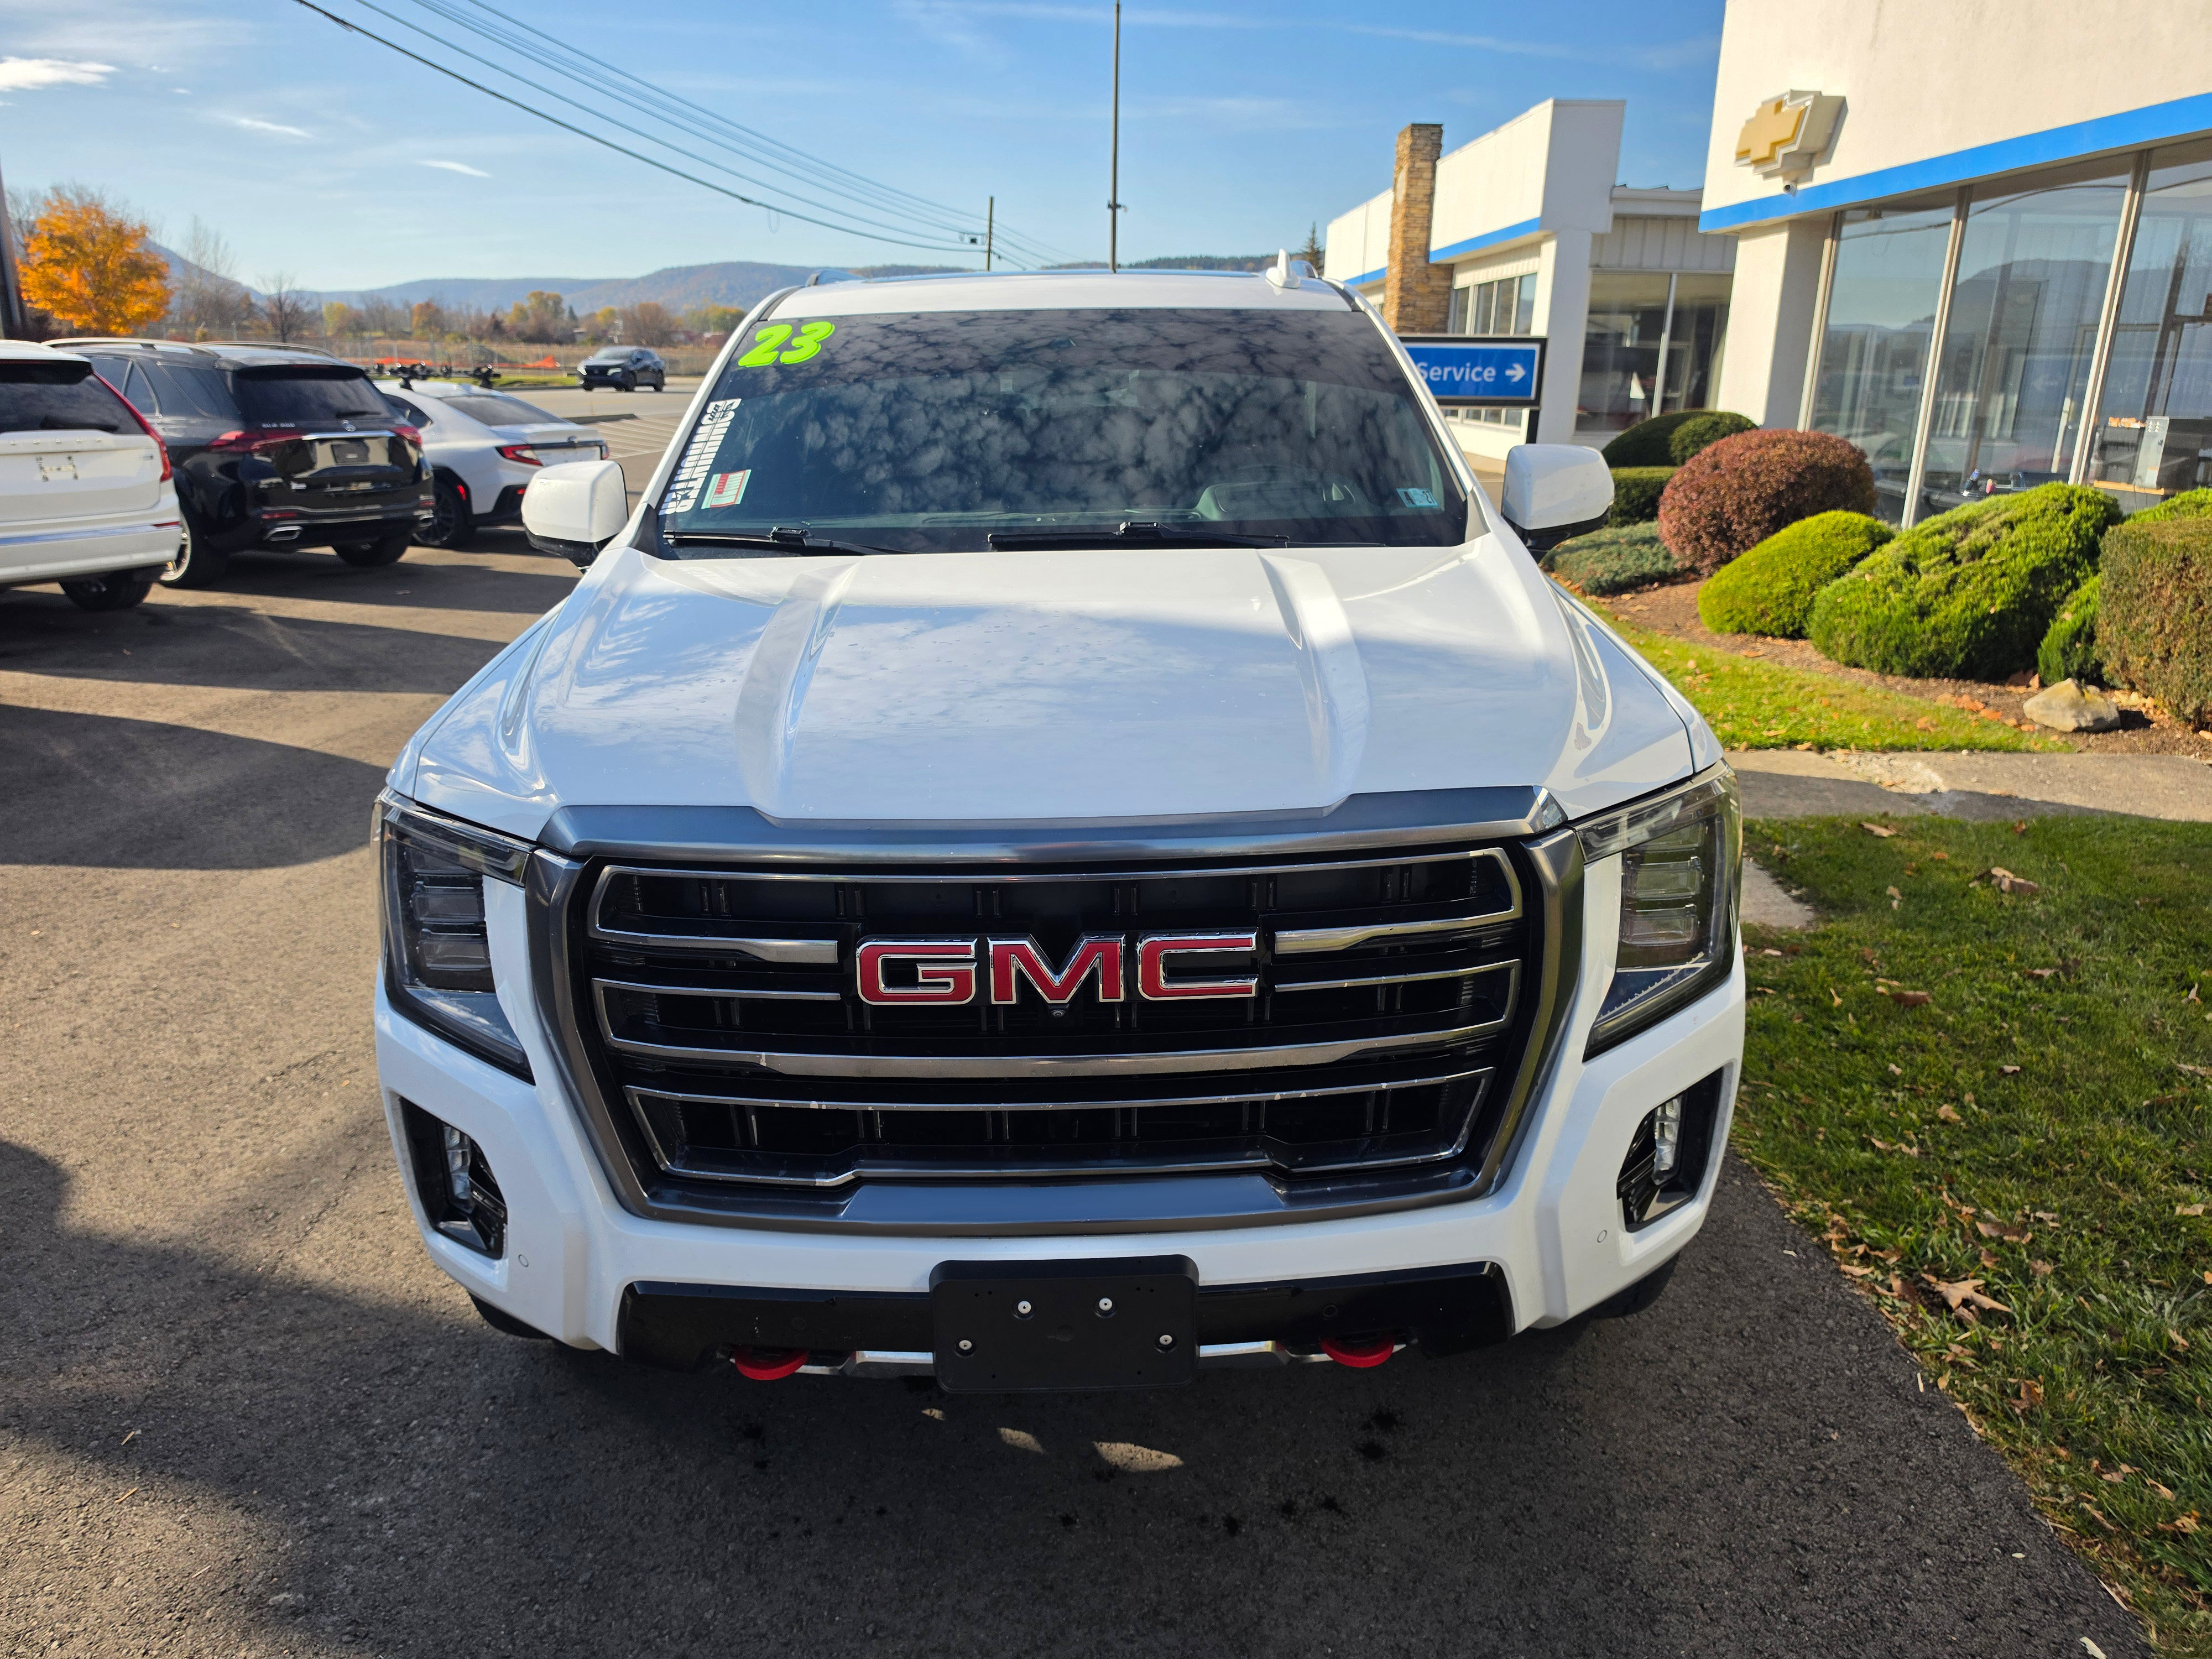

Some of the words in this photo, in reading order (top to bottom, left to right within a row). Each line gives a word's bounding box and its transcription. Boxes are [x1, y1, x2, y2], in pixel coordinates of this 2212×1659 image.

[738, 321, 834, 367] 23
[1416, 361, 1496, 382] Service
[856, 927, 1259, 1005] GMC
